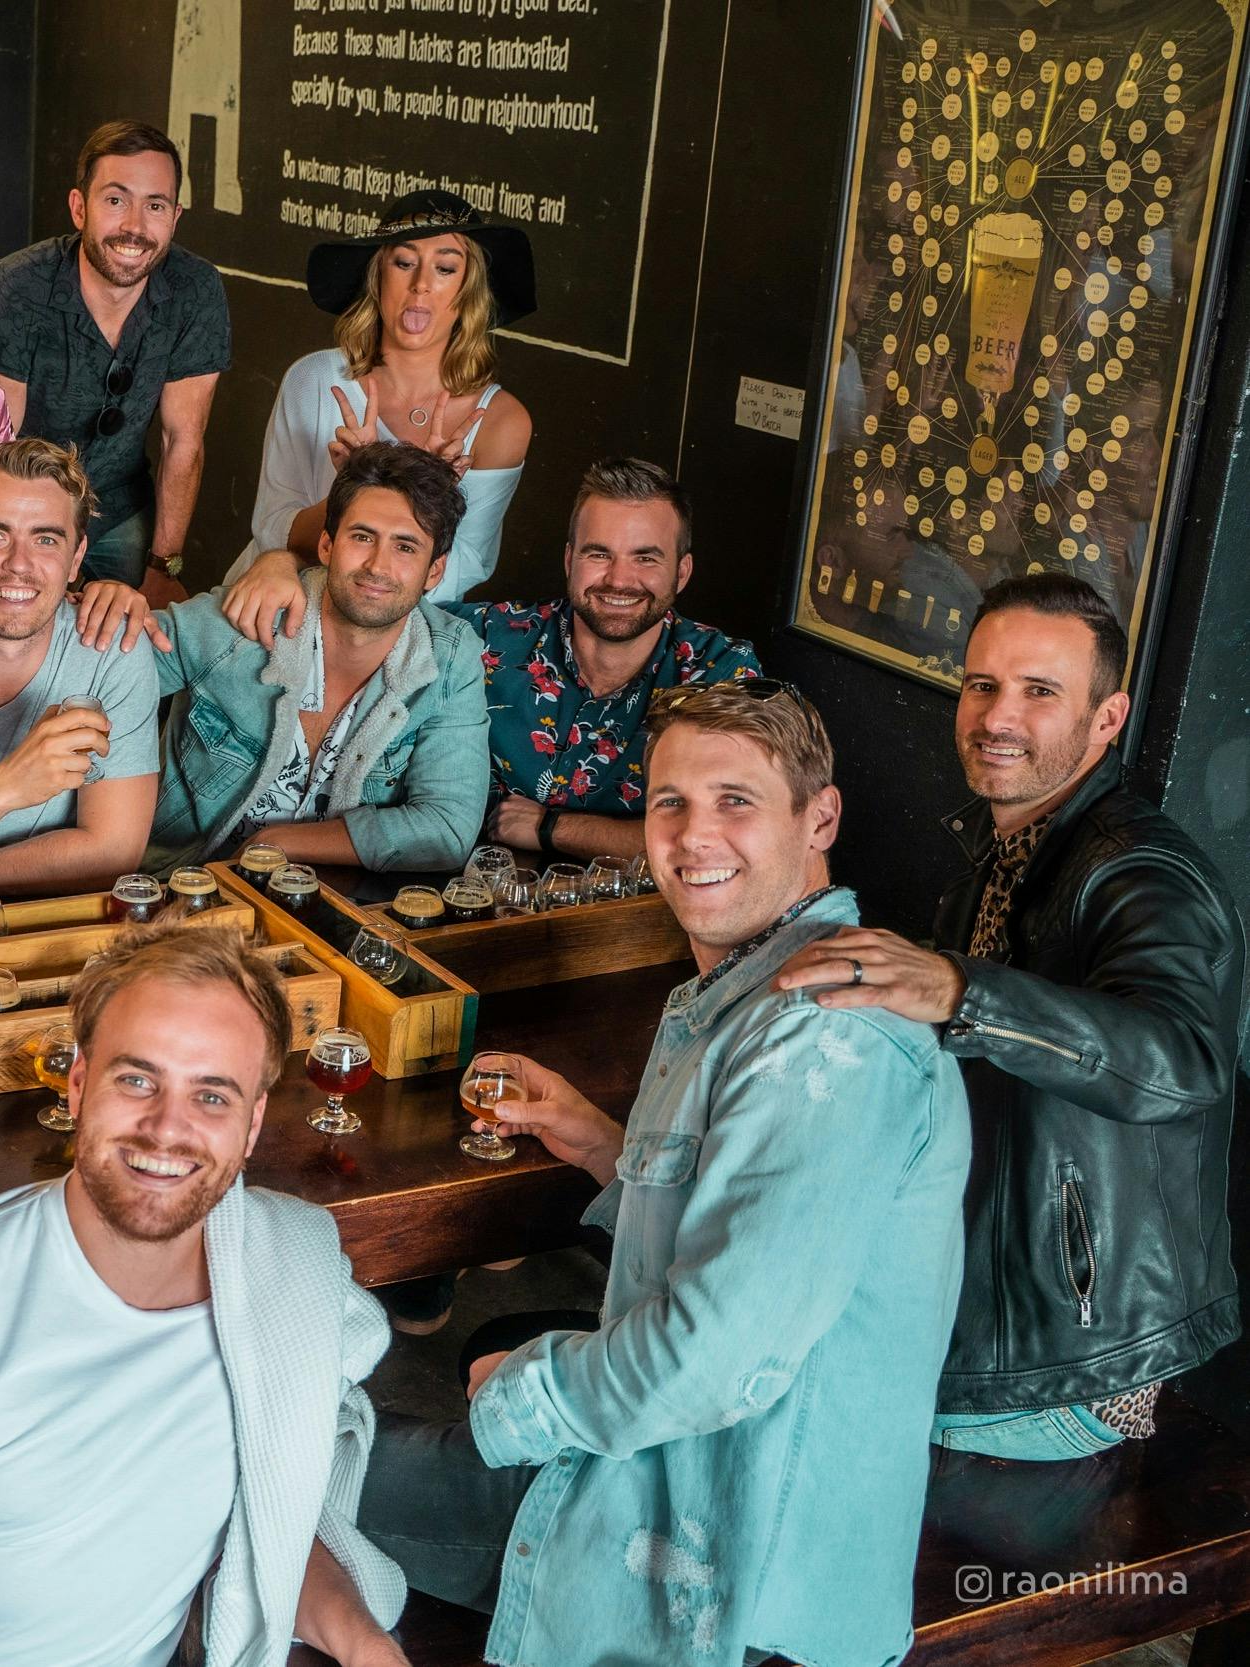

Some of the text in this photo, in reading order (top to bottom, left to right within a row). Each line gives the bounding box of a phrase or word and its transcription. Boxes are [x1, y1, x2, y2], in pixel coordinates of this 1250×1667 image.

[293, 24, 570, 73] Because these small batches are handcrafted
[291, 74, 599, 135] specially for you, the people in our neighbourhood.
[282, 149, 296, 179] So
[298, 156, 341, 187] welcome
[343, 164, 364, 193] and
[498, 182, 535, 222] times
[538, 194, 566, 226] and
[281, 197, 382, 239] stories while enjoyi
[972, 335, 1016, 361] BEER
[743, 379, 766, 395] PLEASE
